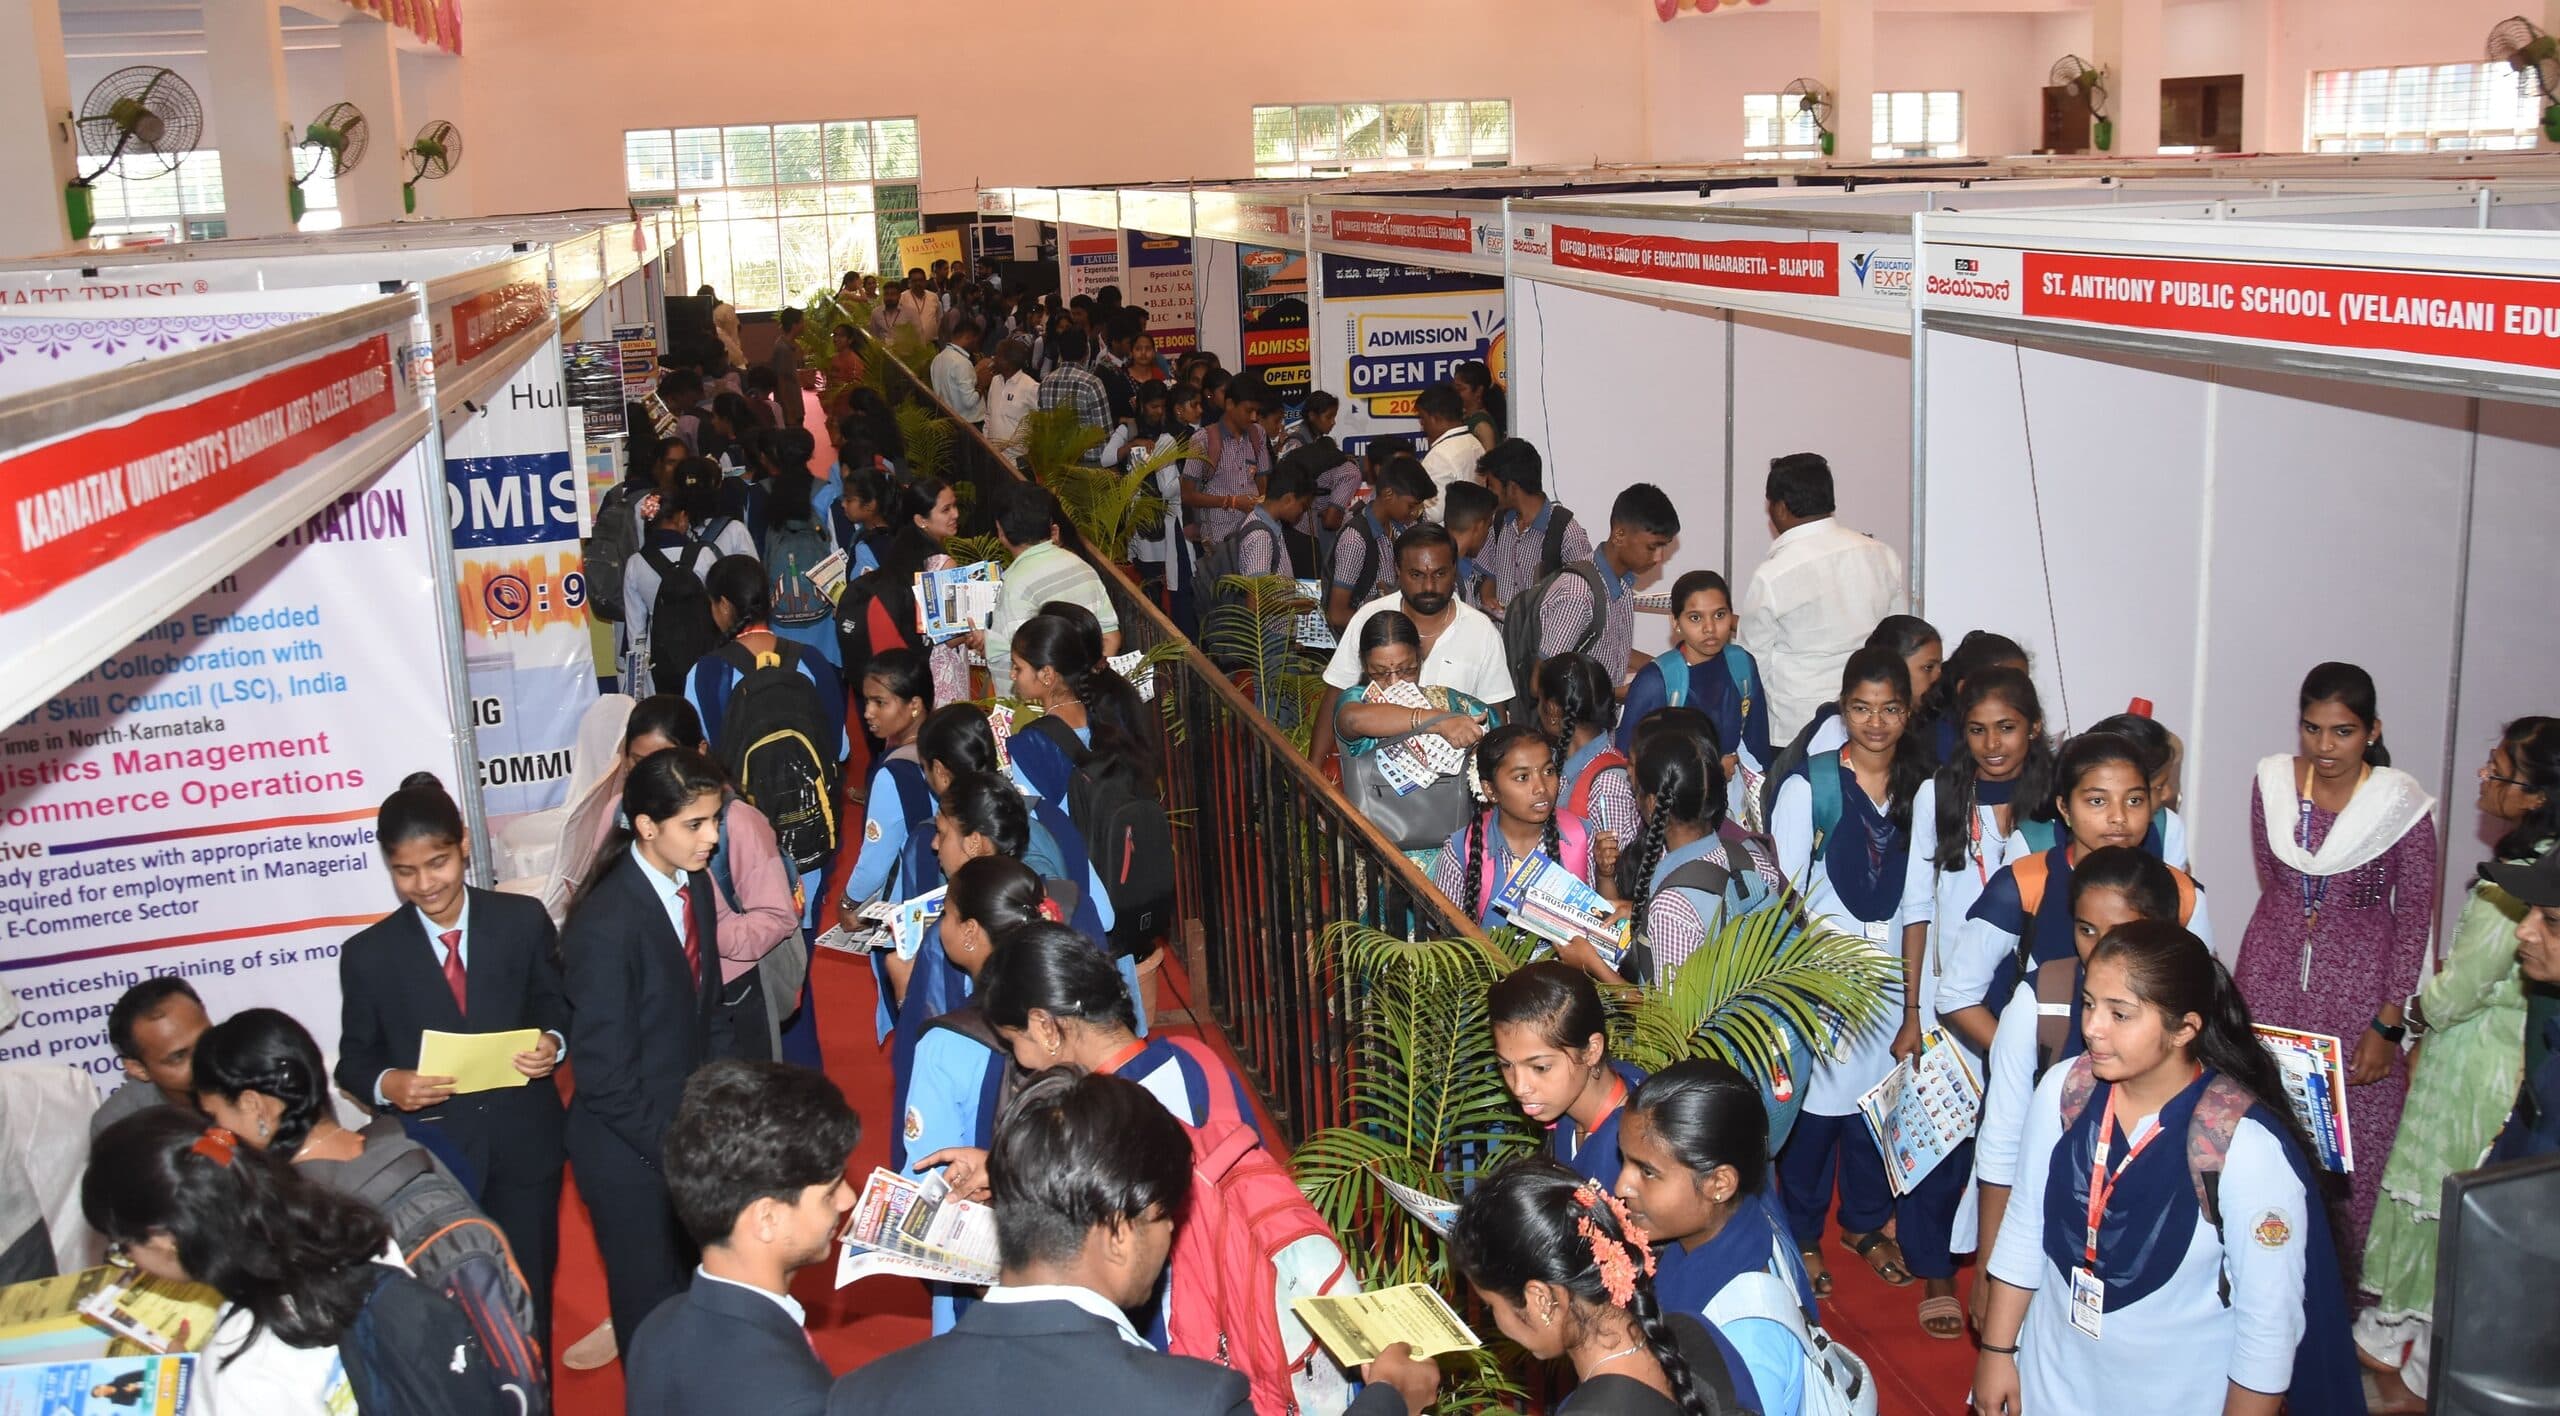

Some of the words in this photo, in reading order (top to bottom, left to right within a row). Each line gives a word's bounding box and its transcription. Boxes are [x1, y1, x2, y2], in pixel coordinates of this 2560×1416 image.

[1417, 227, 1438, 238] COLLEGE
[1439, 227, 1465, 240] DHARWAD
[1150, 270, 1179, 280] Special
[1560, 239, 1587, 257] OXFORD
[1614, 248, 1640, 264] GROUP
[1642, 250, 1652, 265] OF
[1654, 251, 1700, 269] EDUCATION
[1702, 255, 1767, 275] NAGARABETTA
[1779, 258, 1825, 278] BIJAPUR
[80, 282, 183, 300] TRUST
[1149, 284, 1168, 293] IAS
[1150, 298, 1176, 308] B.Ed.
[1926, 275, 2010, 301] ವಿಜಯವಾಣಿ
[2042, 272, 2066, 296] ST.
[2070, 275, 2154, 303] ANTHONY
[2160, 283, 2234, 310] PUBLIC
[2240, 286, 2331, 319] SCHOOL
[2339, 292, 2494, 333] (VELANGANI
[1151, 313, 1169, 323] LIC
[1166, 335, 1195, 347] BOOKS
[1368, 327, 1468, 347] ADMISSION
[1266, 371, 1294, 382] OPEN
[1353, 361, 1424, 386] OPEN
[16, 466, 128, 553] KARNATAK
[126, 434, 230, 506] UNIVERSITY'S
[228, 409, 288, 464] KARNATAK
[286, 398, 312, 435] ARTS
[312, 377, 351, 425] COLLEGE
[192, 604, 320, 637] Embedded
[101, 646, 266, 681] Colloboration
[273, 640, 323, 664] with
[48, 693, 99, 722] Skill
[107, 684, 202, 715] Council
[210, 679, 282, 710] (LSC),
[290, 671, 348, 698] India
[45, 733, 63, 750] in
[68, 715, 226, 749] North-Karnataka
[112, 731, 331, 777] Management
[181, 768, 365, 809] Operations
[39, 855, 135, 888] graduates
[142, 847, 185, 870] with
[191, 833, 302, 865] appropriate
[0, 887, 73, 916] equired
[79, 879, 107, 903] for
[112, 868, 237, 898] employment
[242, 864, 258, 881] in
[265, 852, 368, 880] Managerial
[9, 909, 132, 938] E-Commerce
[138, 899, 199, 921] Sector
[1541, 893, 1574, 914] SRUSHTI
[1576, 912, 1620, 937] ACADYS
[146, 952, 235, 980] Training
[242, 947, 263, 969] of
[269, 944, 297, 965] six
[305, 943, 341, 961] mo
[2322, 1110, 2333, 1129] TRACK
[2327, 1129, 2338, 1153] RECORD
